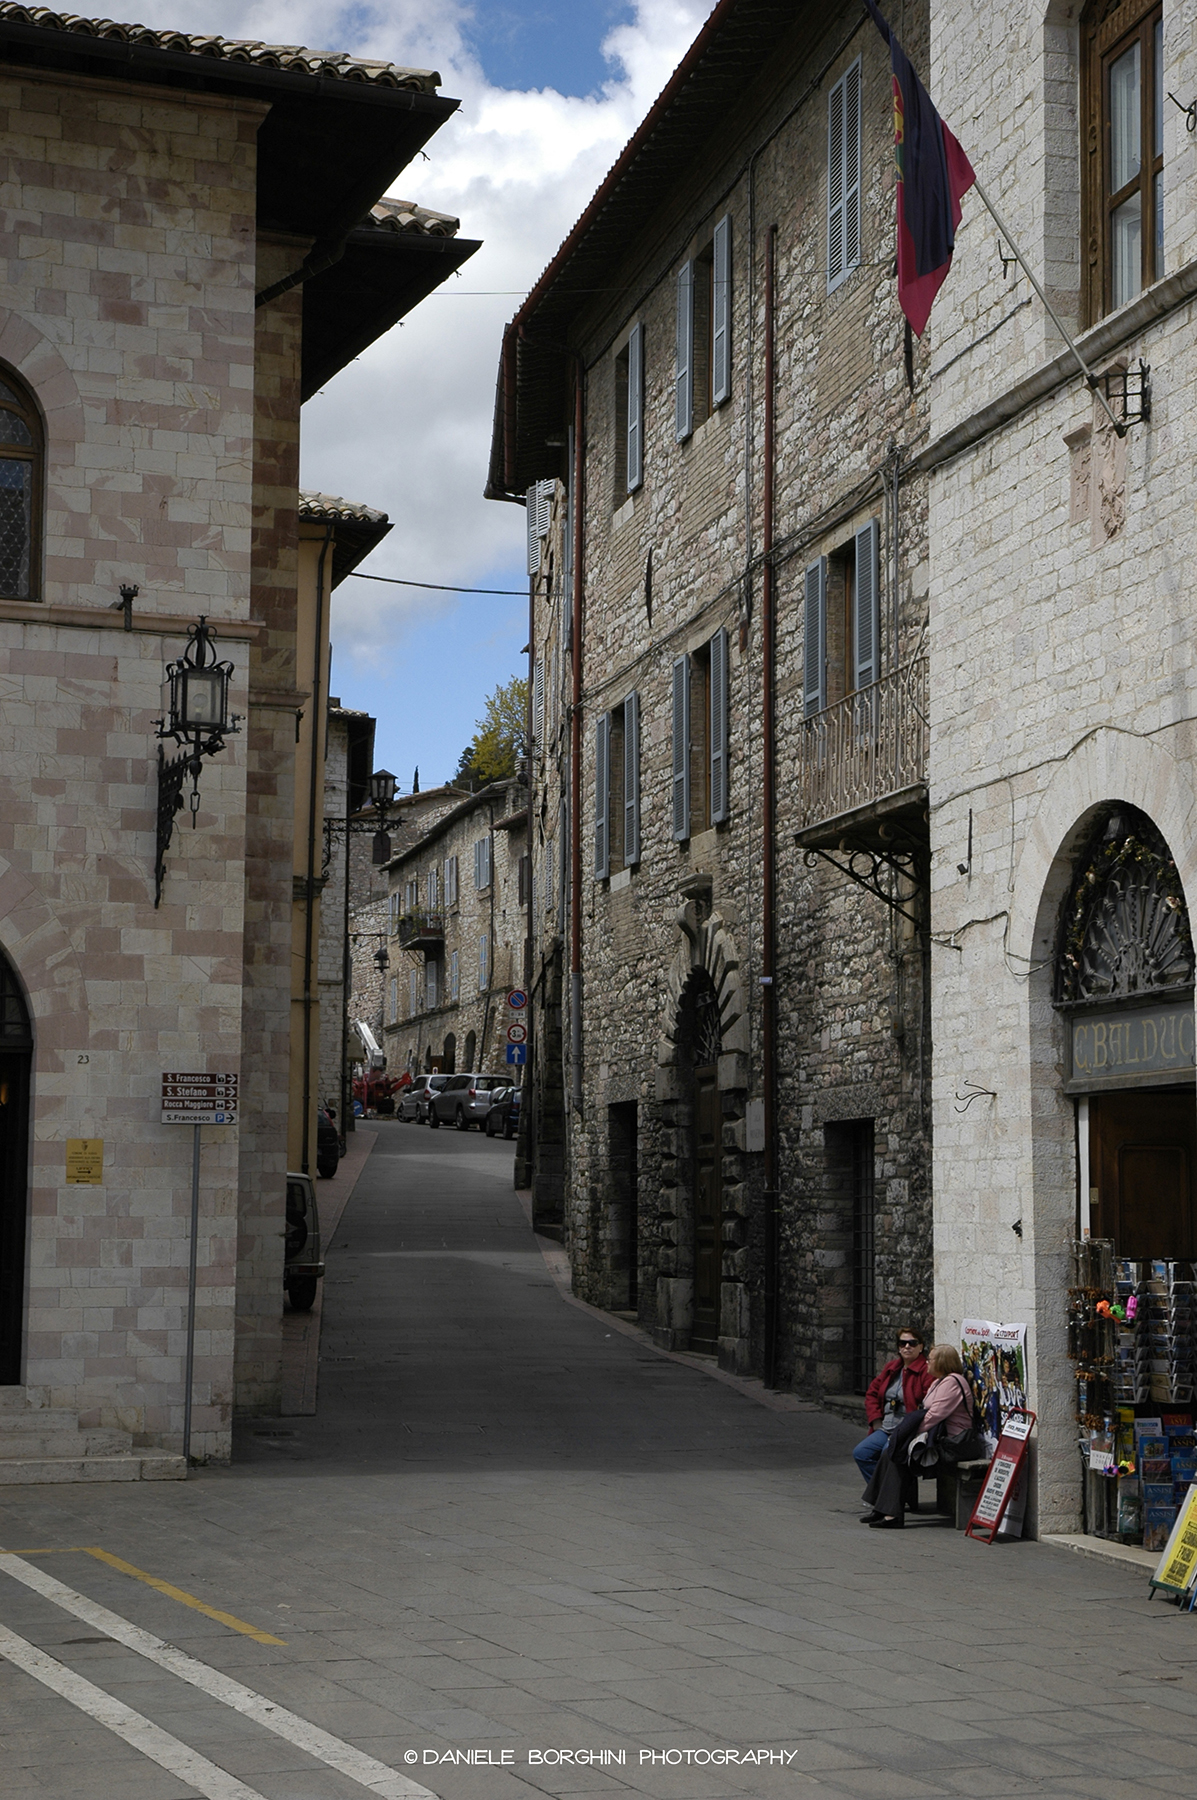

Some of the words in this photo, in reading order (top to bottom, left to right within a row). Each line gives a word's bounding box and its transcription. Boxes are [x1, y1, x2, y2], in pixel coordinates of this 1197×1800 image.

[77, 1055, 89, 1064] 23
[167, 1074, 174, 1082] S.
[176, 1074, 211, 1082] Francesco
[166, 1087, 174, 1096] S.
[177, 1087, 207, 1096] Stefano
[184, 1100, 214, 1109] Maggiore
